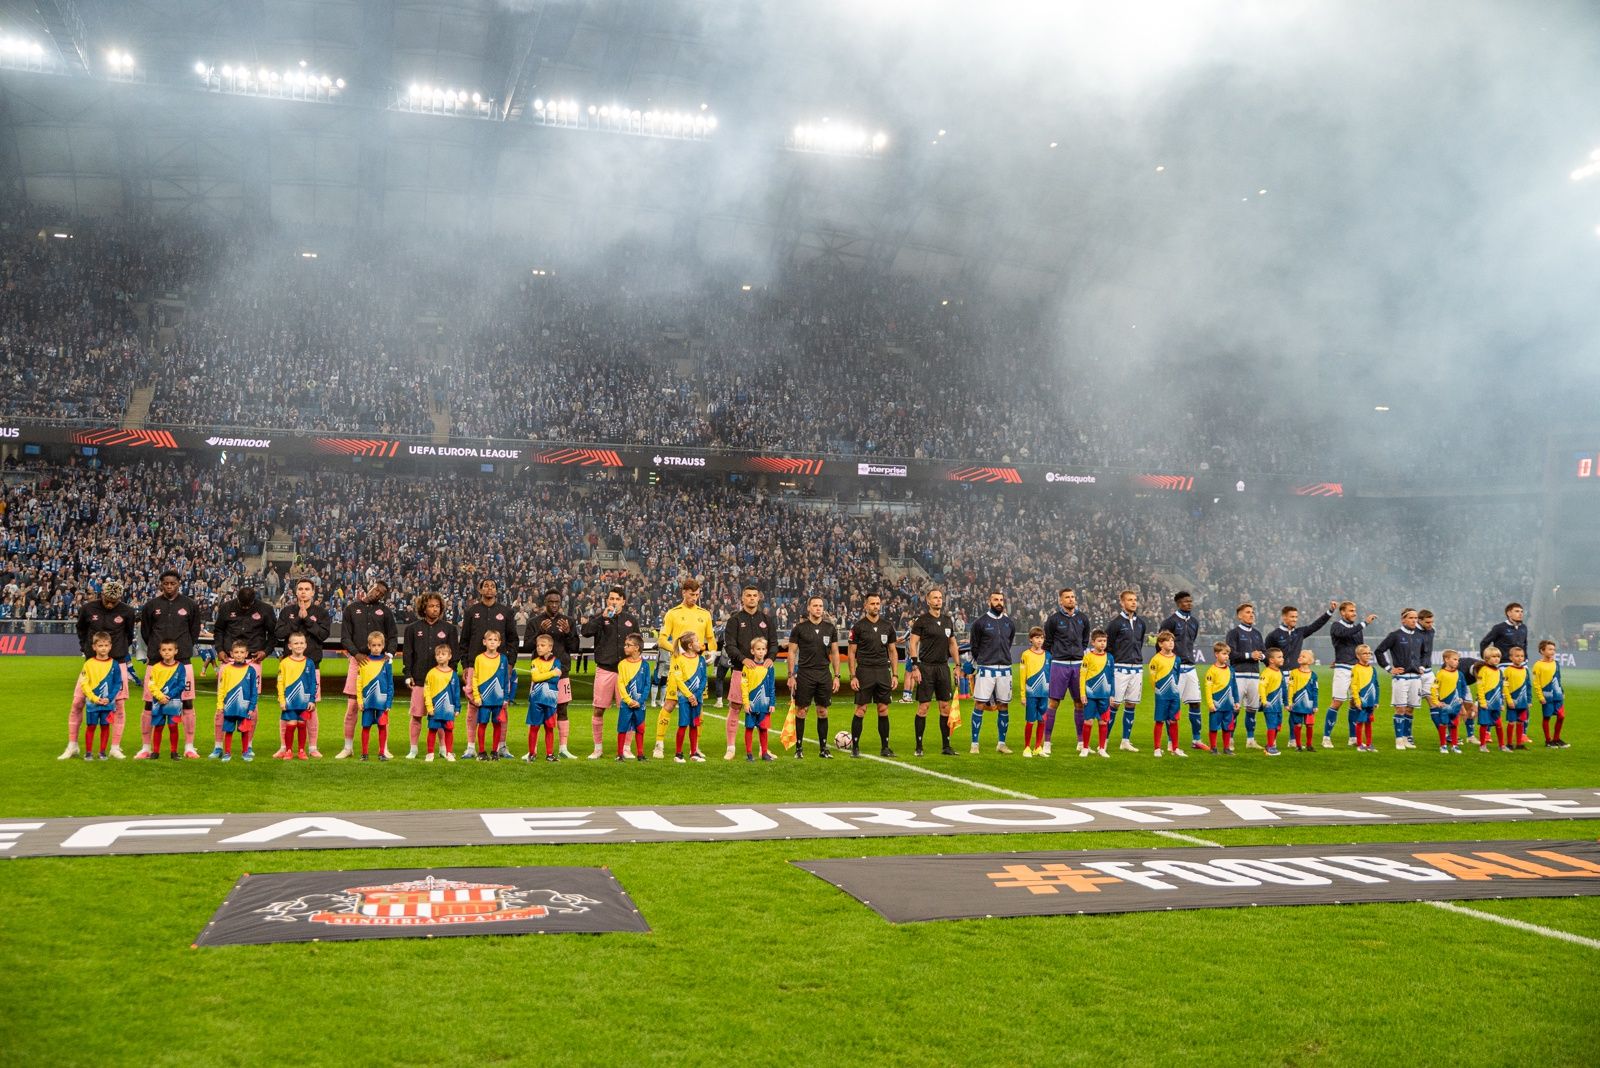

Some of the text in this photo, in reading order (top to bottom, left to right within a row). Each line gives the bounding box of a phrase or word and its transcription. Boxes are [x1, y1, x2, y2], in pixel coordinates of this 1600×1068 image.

[409, 445, 519, 459] UEFA EUROPA LEAGUE
[663, 456, 706, 467] STRAUSS
[1054, 473, 1096, 484] Swissquote
[479, 799, 1392, 838] EUROPA
[333, 911, 529, 926] SUNDERLAND A.F.C.
